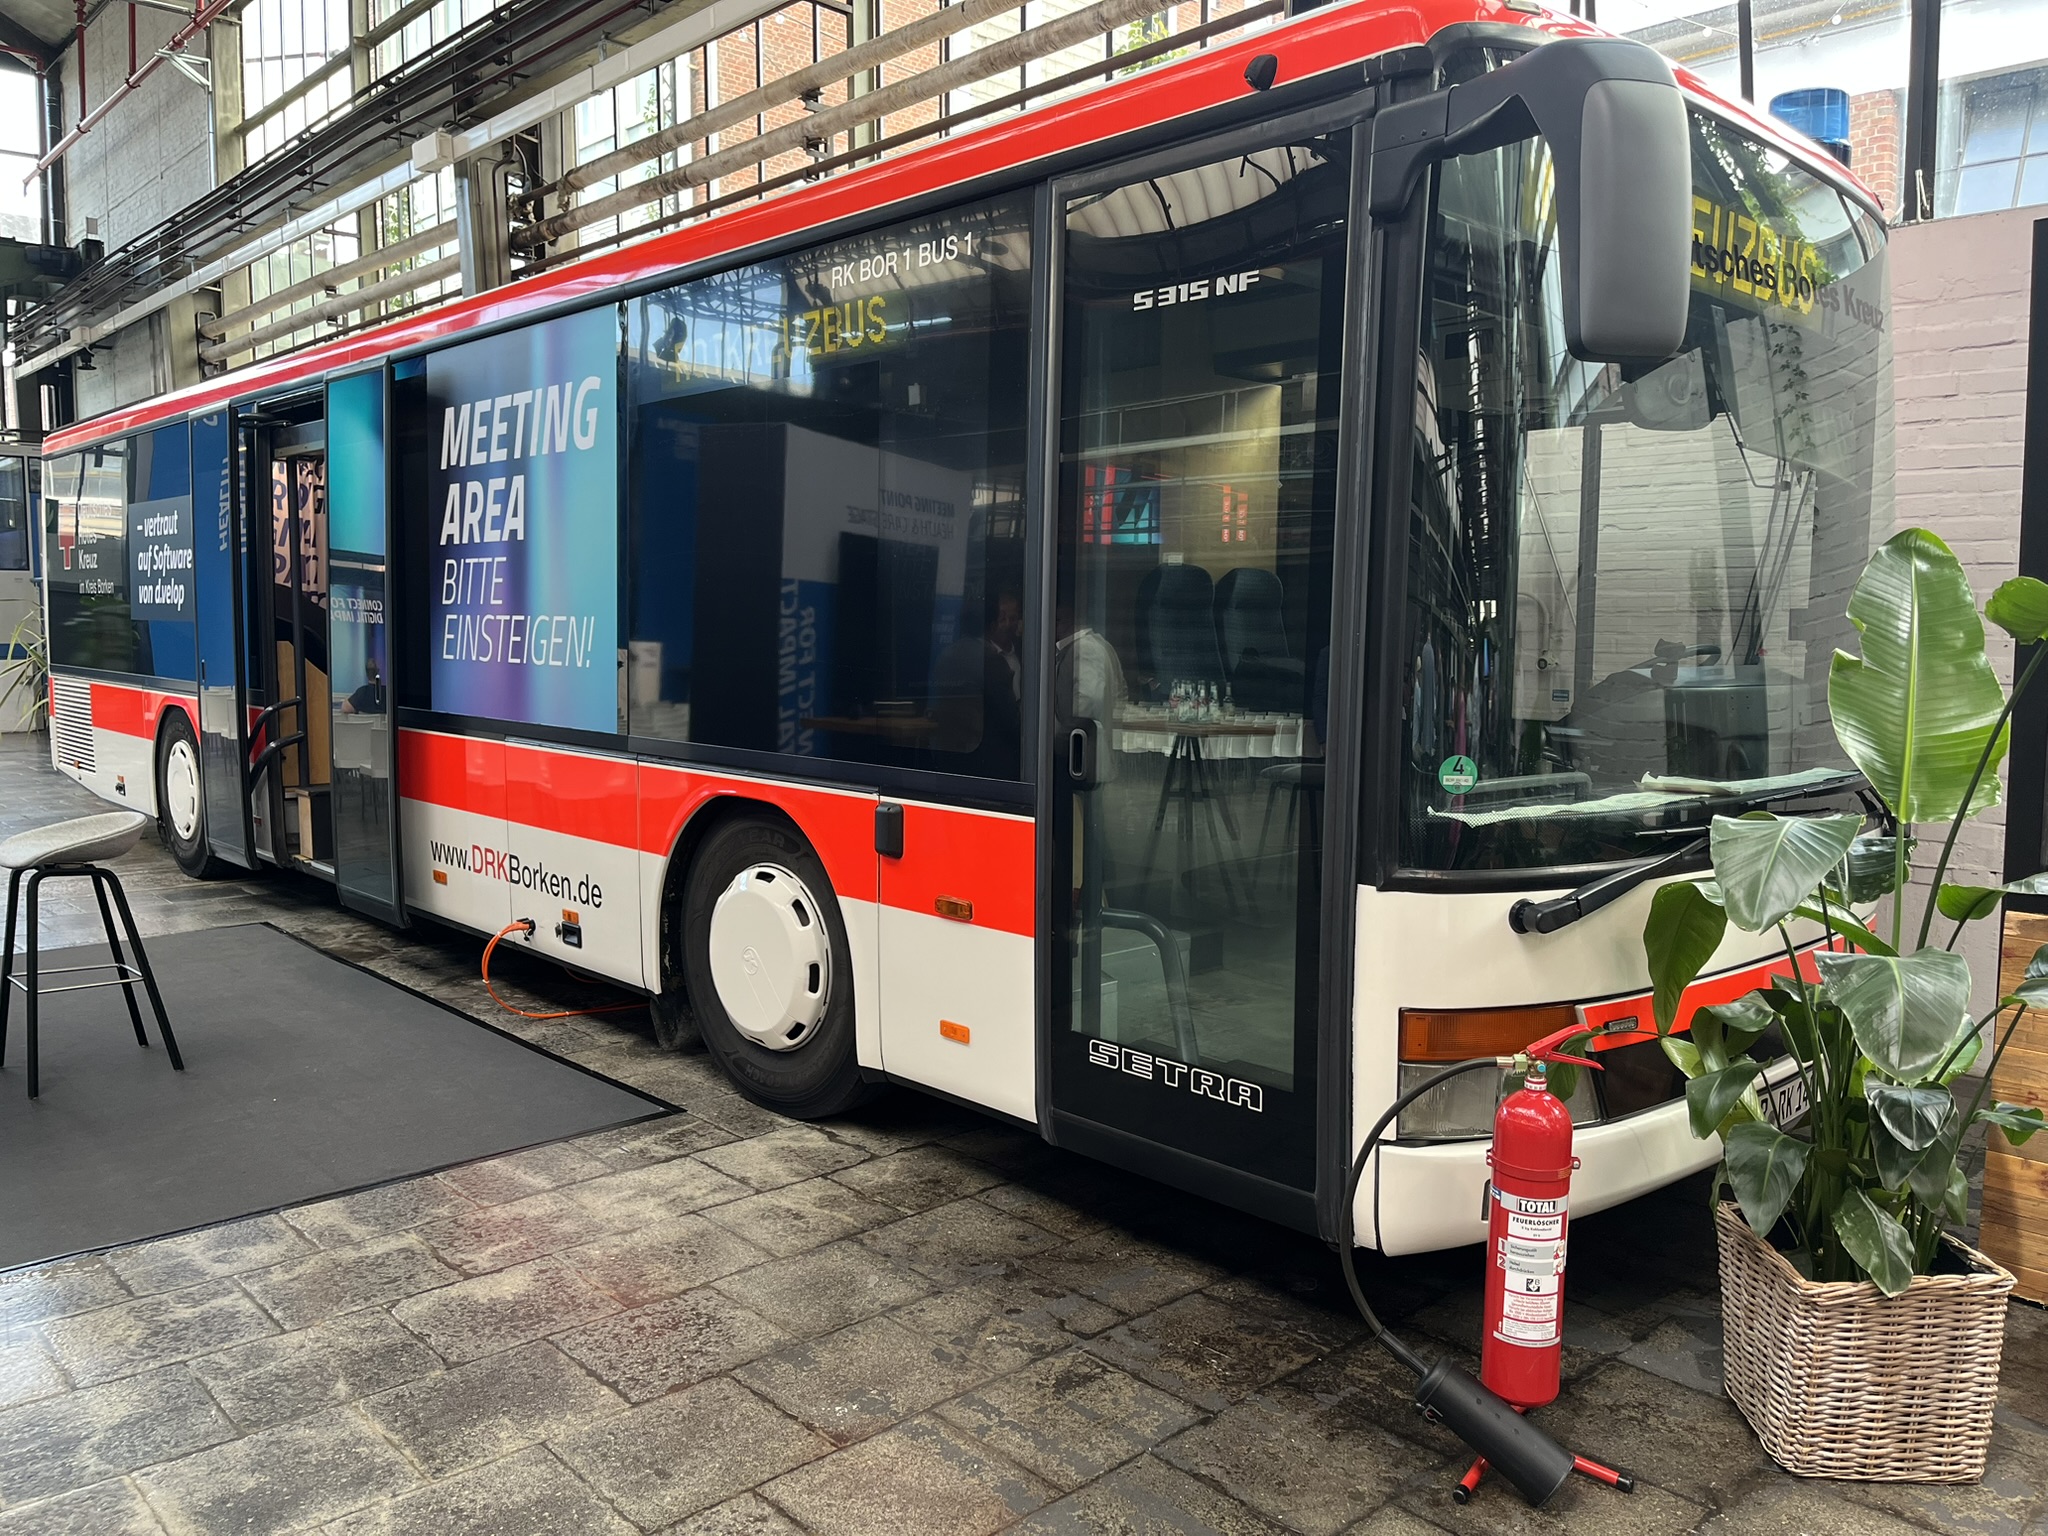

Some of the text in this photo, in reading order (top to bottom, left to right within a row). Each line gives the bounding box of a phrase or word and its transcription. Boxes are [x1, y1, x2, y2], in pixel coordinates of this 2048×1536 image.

[831, 232, 973, 289] RK BOR 1 BUS 1
[1691, 194, 1817, 316] EUZBUS
[1133, 269, 1260, 311] S 315 NF
[1691, 233, 1885, 334] tsches Rotes Kreuz
[440, 375, 601, 470] MEETING
[144, 510, 178, 537] vertraut
[439, 474, 525, 546] AREA
[78, 549, 98, 570] Kreuz
[138, 545, 192, 578] auf Software
[97, 579, 114, 594] Borken
[138, 578, 185, 611] von d.velop
[441, 556, 508, 606] BITTE
[441, 614, 596, 669] EINSTEIGEN!
[1452, 756, 1465, 775] 4
[430, 840, 603, 908] www.DRKBorken.de
[1089, 1039, 1263, 1112] SETRA
[1779, 1085, 1795, 1120] RK
[1512, 1216, 1560, 1226] FEUERLÖSCHER
[1519, 1199, 1555, 1214] TOTAL
[1498, 1255, 1506, 1269] 2
